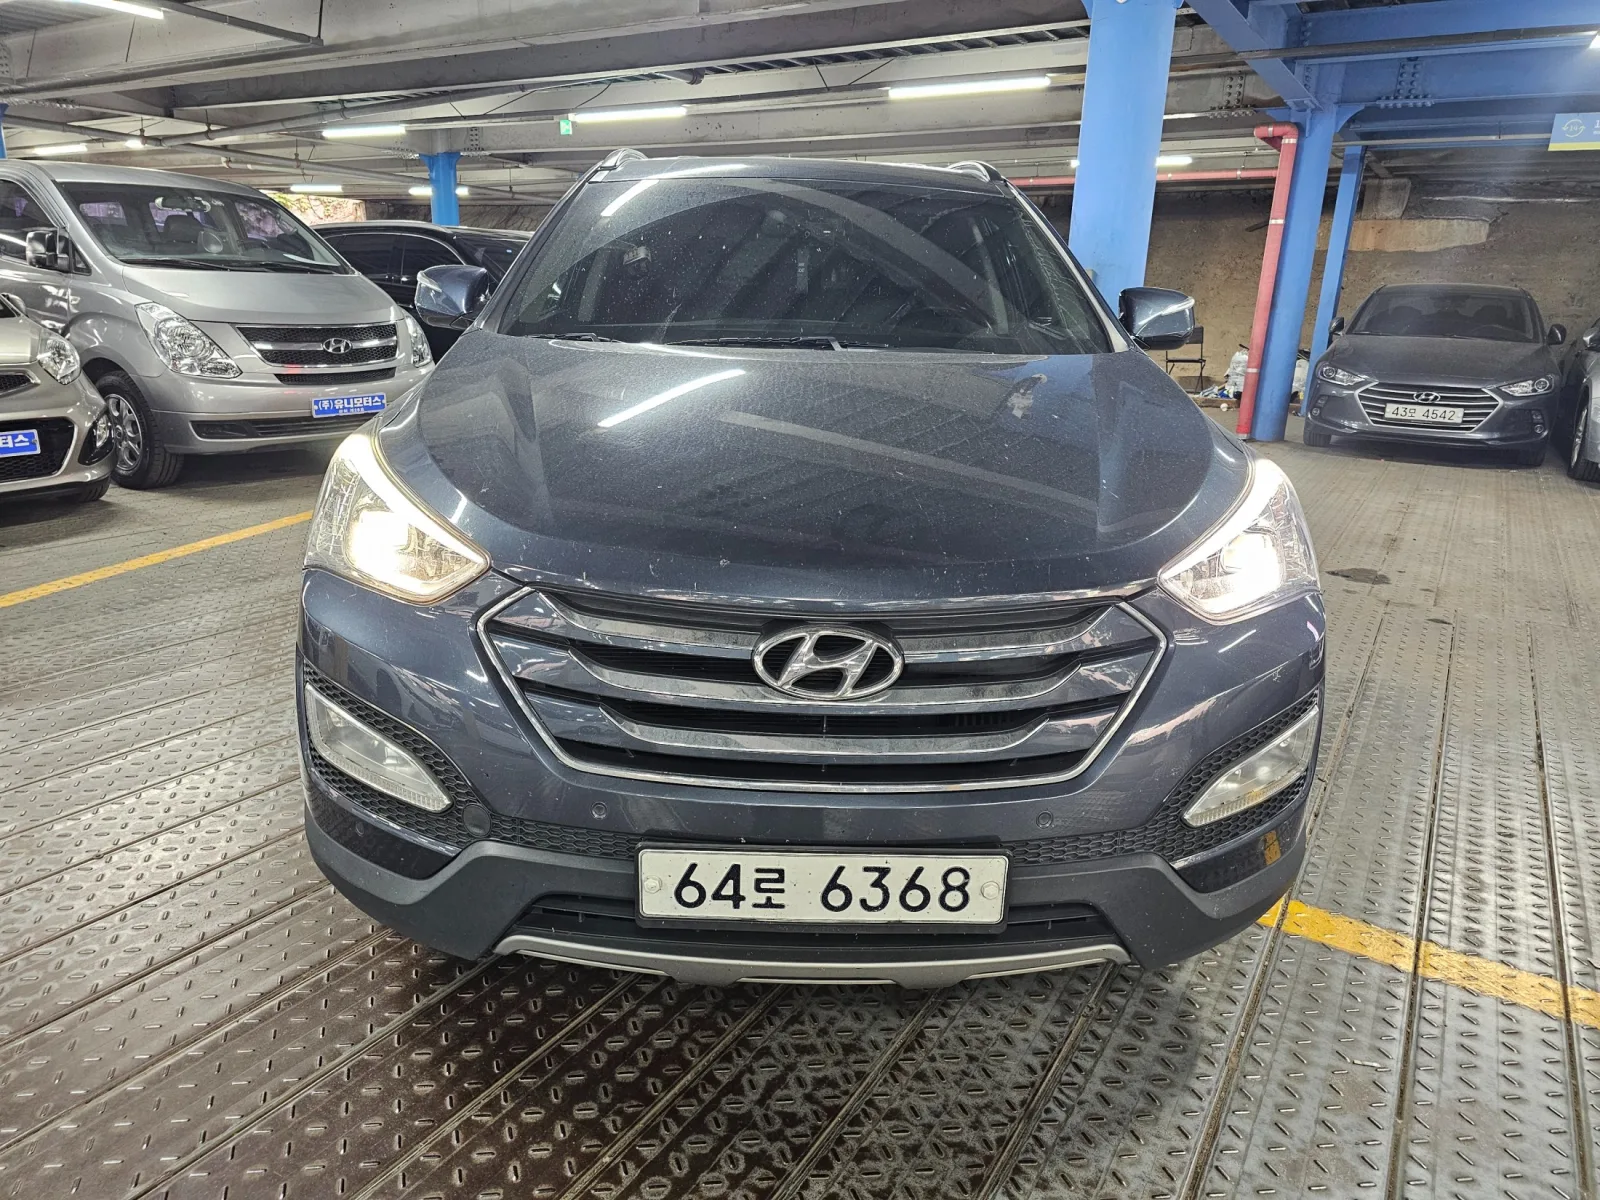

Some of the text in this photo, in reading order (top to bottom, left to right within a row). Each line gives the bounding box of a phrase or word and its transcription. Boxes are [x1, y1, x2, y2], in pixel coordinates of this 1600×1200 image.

[1391, 406, 1456, 420] 43모 4542
[673, 862, 971, 912] 64로 6368
